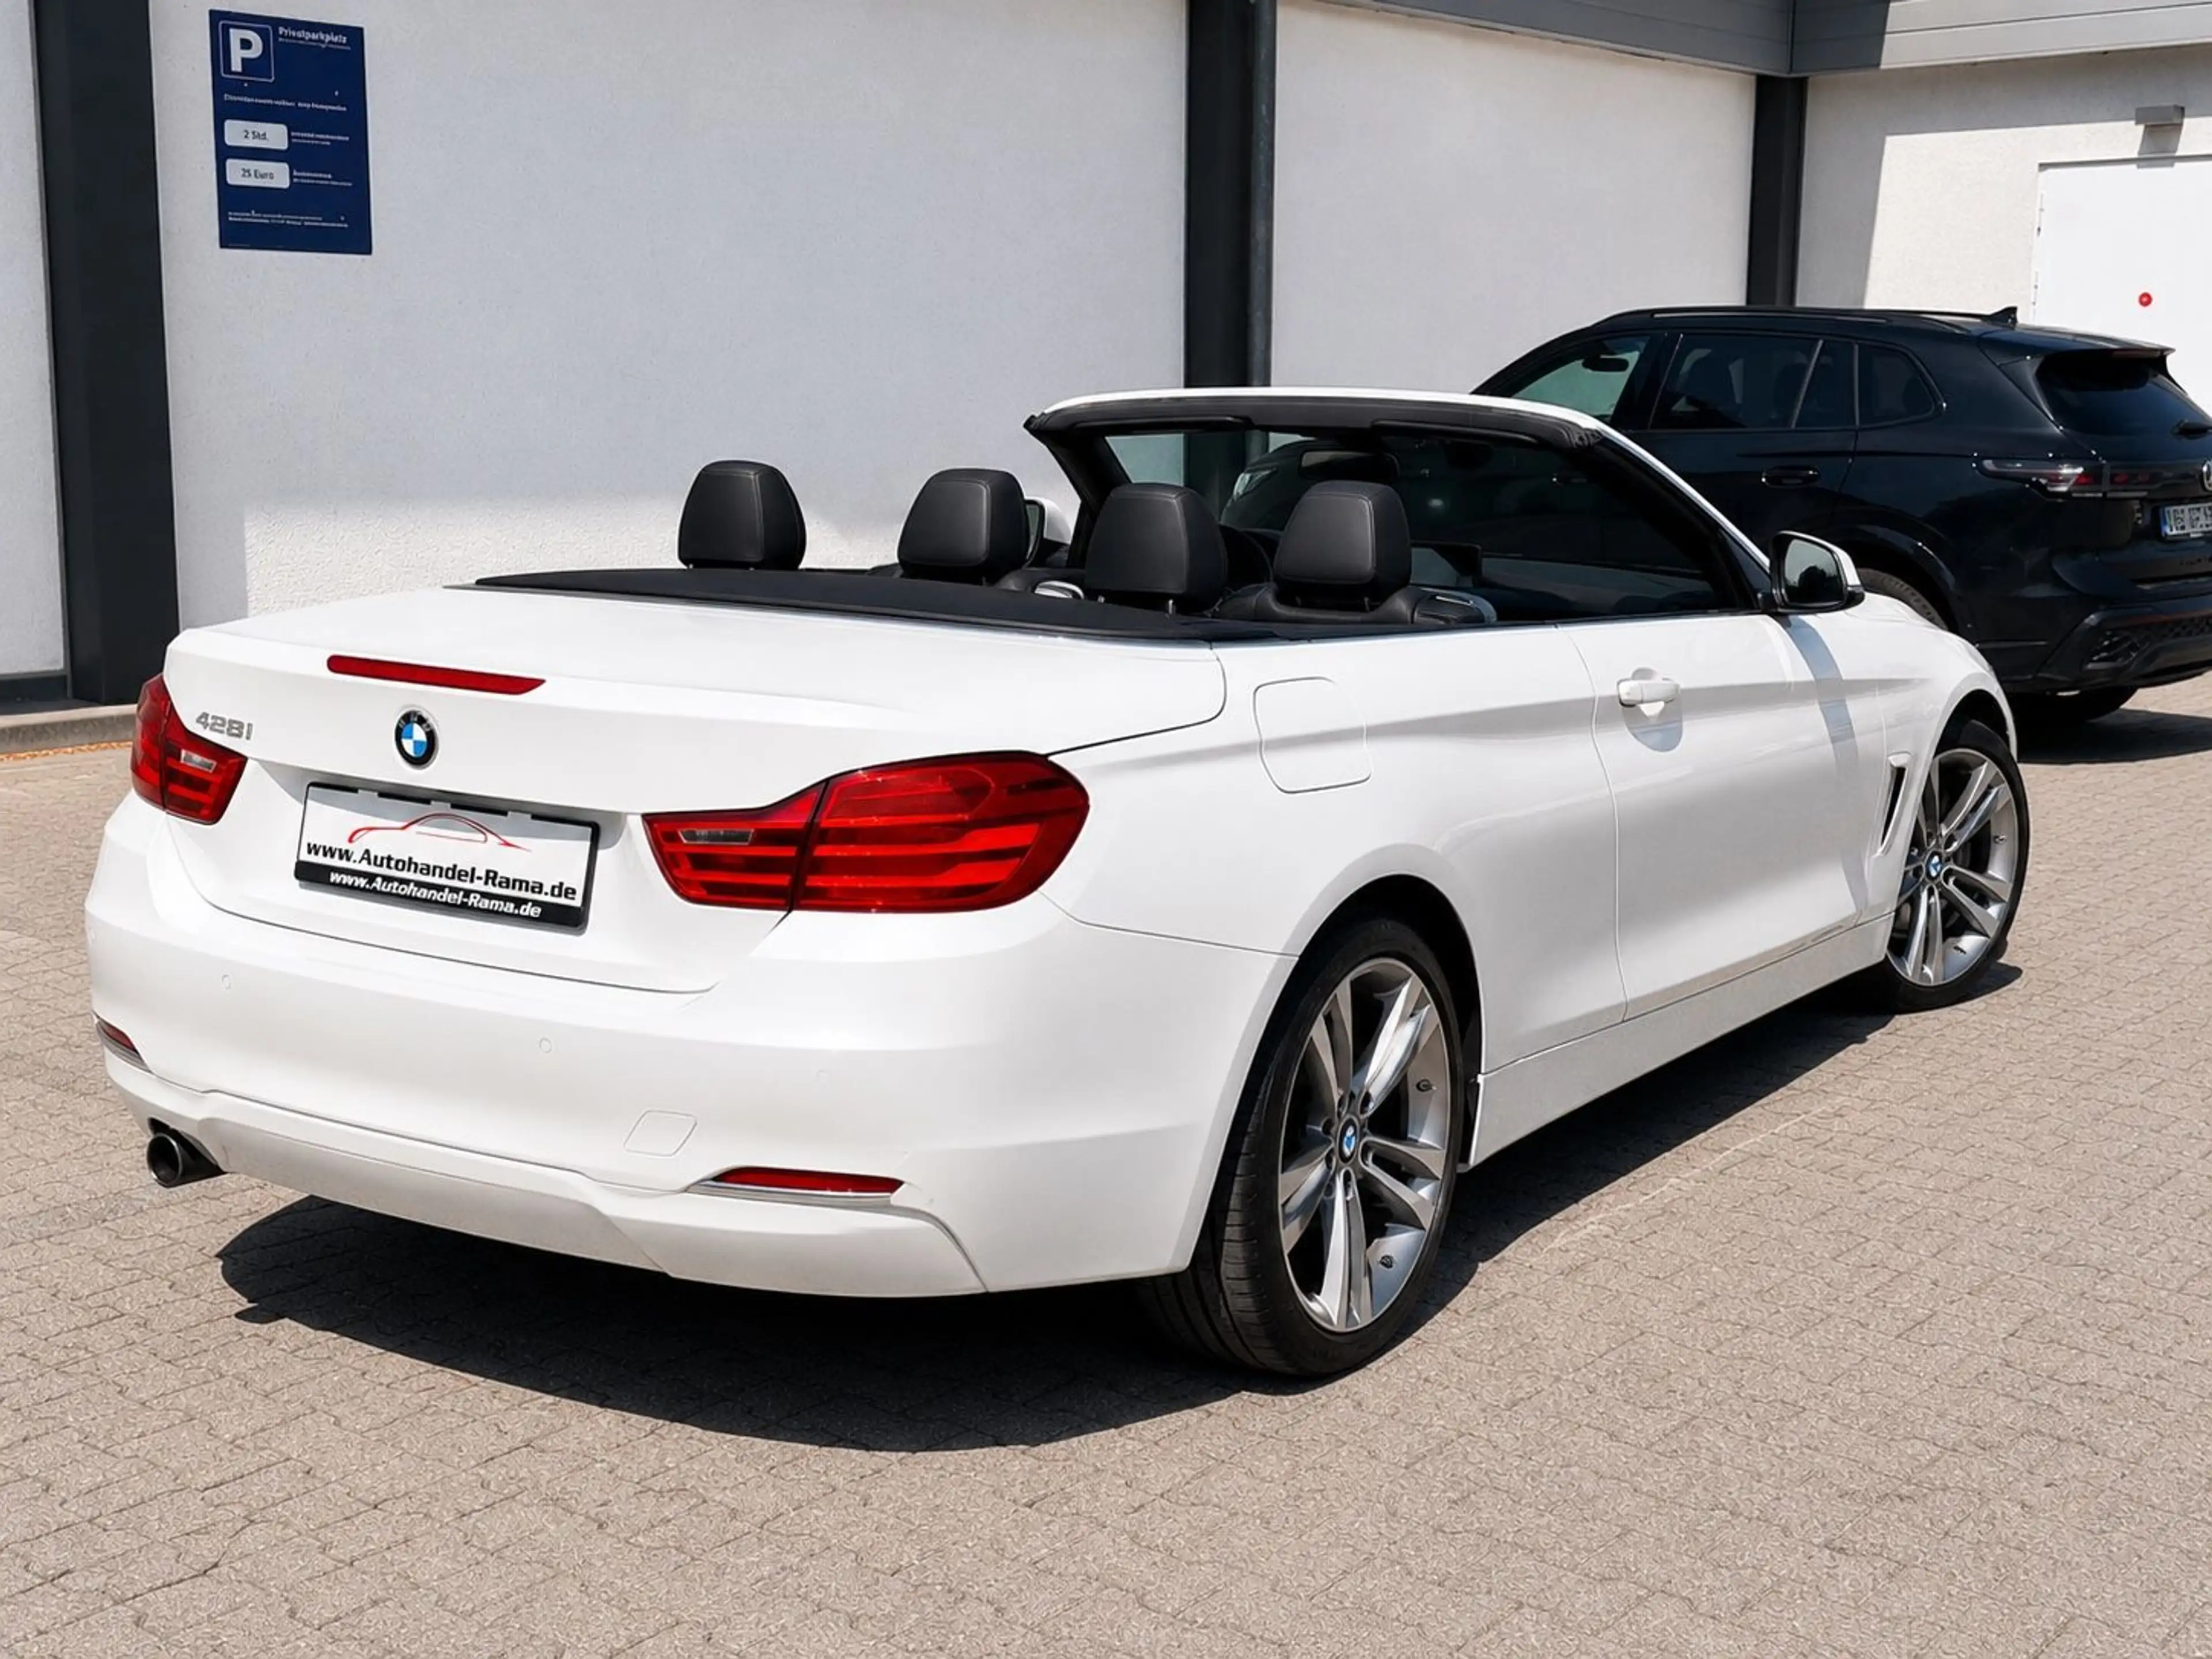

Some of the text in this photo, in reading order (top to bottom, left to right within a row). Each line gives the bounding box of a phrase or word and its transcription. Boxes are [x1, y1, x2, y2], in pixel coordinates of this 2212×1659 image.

[229, 28, 263, 72] P
[244, 130, 250, 139] 2
[241, 168, 274, 180] 25 Euro
[306, 841, 577, 900] www.Autohandel-Rama.de
[329, 871, 541, 918] www.Autohandel-Rama.de
